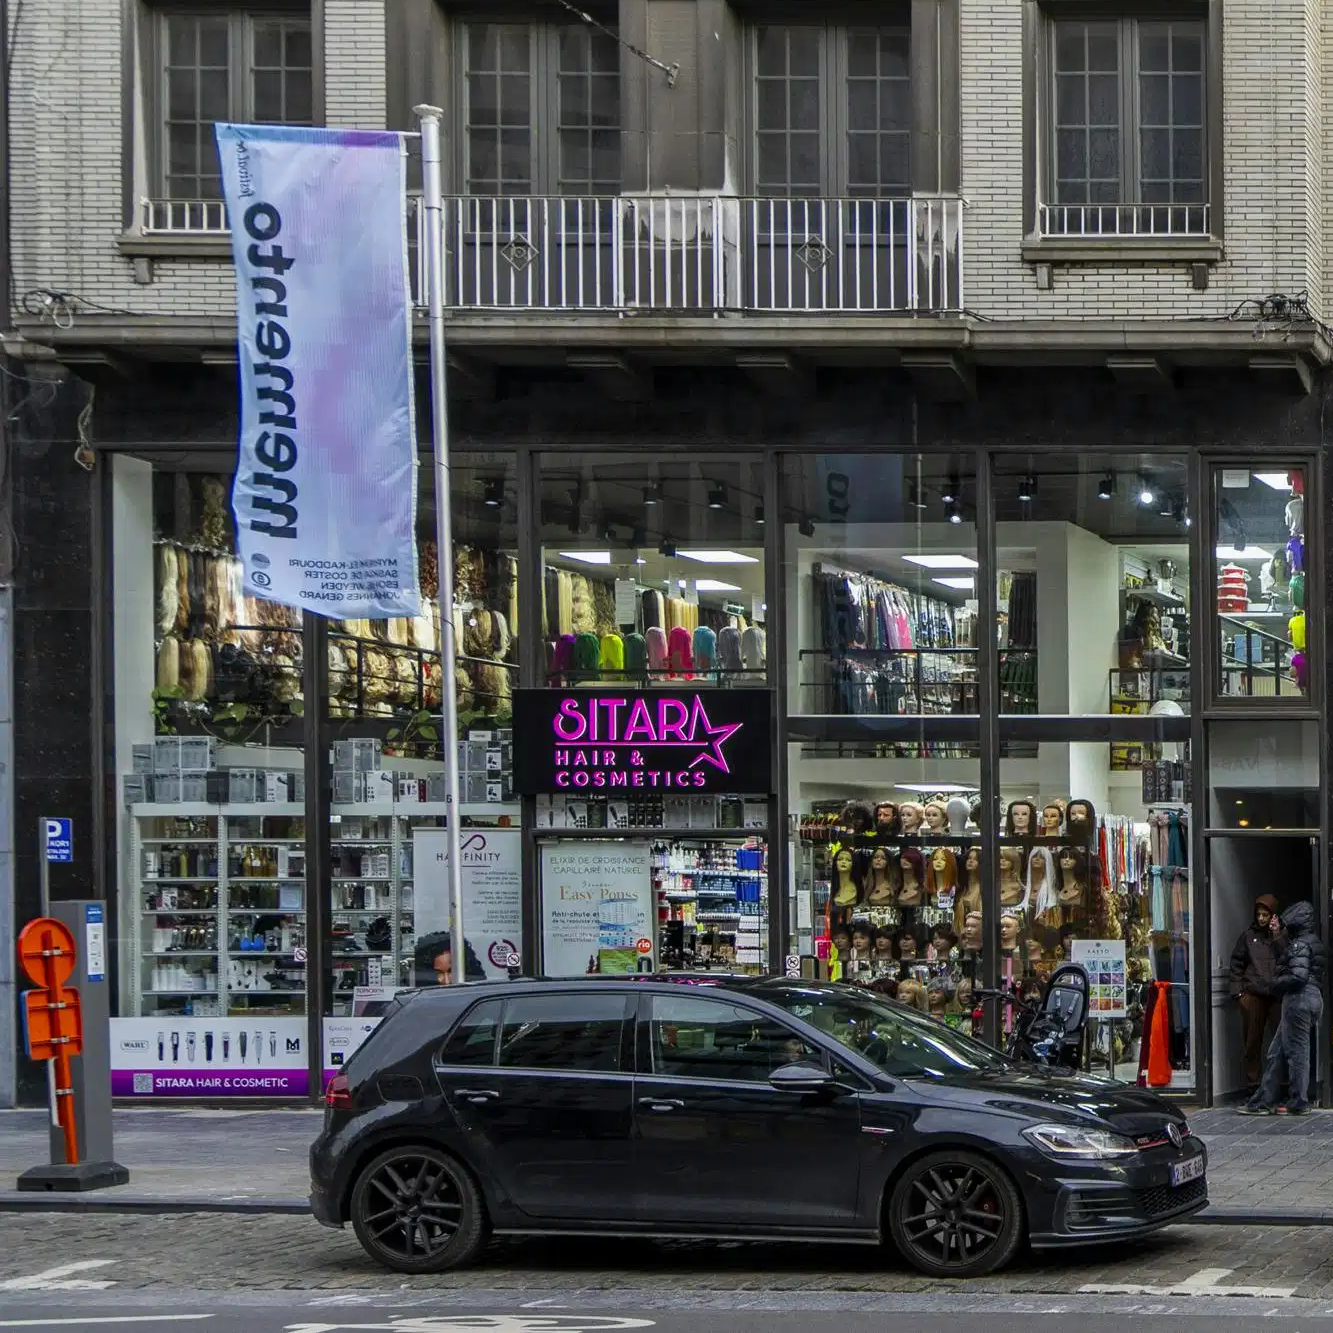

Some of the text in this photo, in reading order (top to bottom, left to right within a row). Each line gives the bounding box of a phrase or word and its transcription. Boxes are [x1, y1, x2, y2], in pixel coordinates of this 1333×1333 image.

[553, 694, 713, 741] SITARA
[555, 749, 645, 766] HAIR &
[555, 771, 706, 787] COSMETICS
[46, 820, 62, 838] P
[436, 853, 501, 862] HAFINITY
[578, 856, 589, 864] DE
[560, 885, 594, 901] Easy
[155, 1077, 289, 1088] SITARA HAIR & COSMETIC
